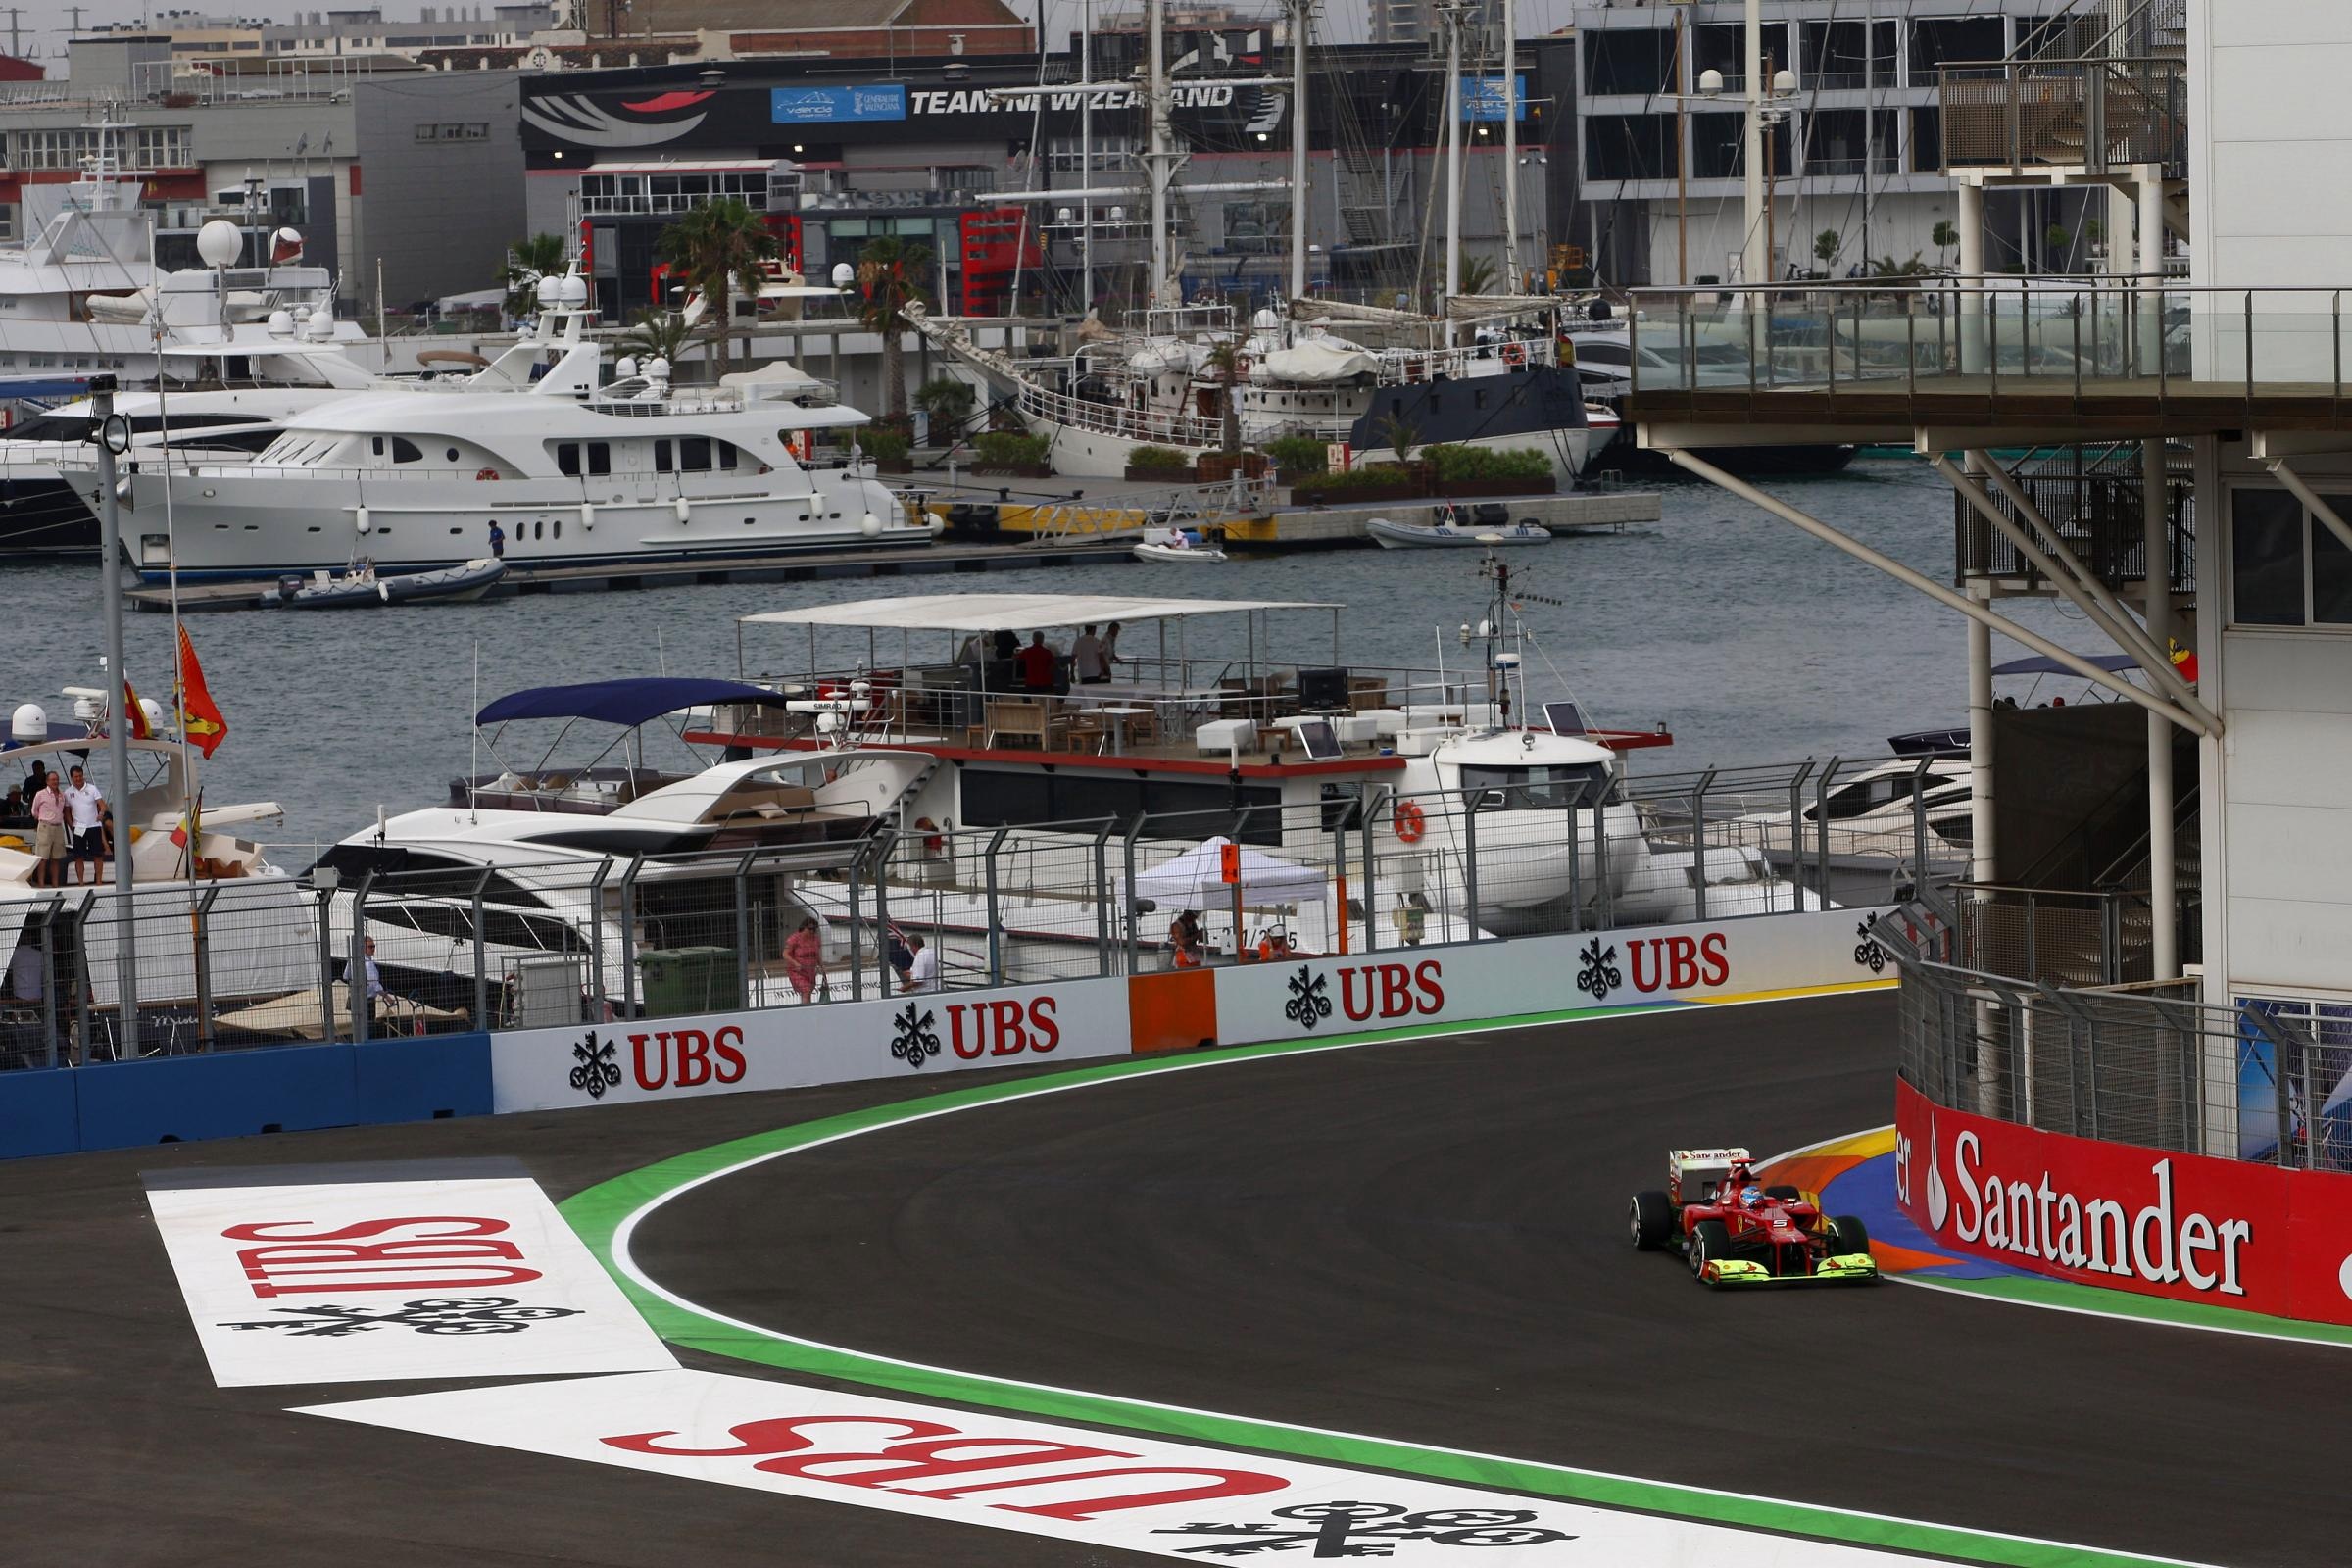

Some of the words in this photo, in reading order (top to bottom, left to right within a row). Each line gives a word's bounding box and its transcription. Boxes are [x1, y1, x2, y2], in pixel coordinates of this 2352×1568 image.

[911, 90, 999, 114] TEAM
[1005, 93, 1082, 112] NW
[1088, 86, 1234, 110] ZEAAND
[1338, 960, 1445, 1021] UBS
[1628, 933, 1729, 992] UBS
[629, 1026, 747, 1090] UBS
[947, 997, 1059, 1059] UBS
[1773, 1219, 1788, 1228] 5
[1955, 1130, 2250, 1296] Santander
[221, 1216, 543, 1298] UBS
[600, 1415, 1292, 1522] UBS
